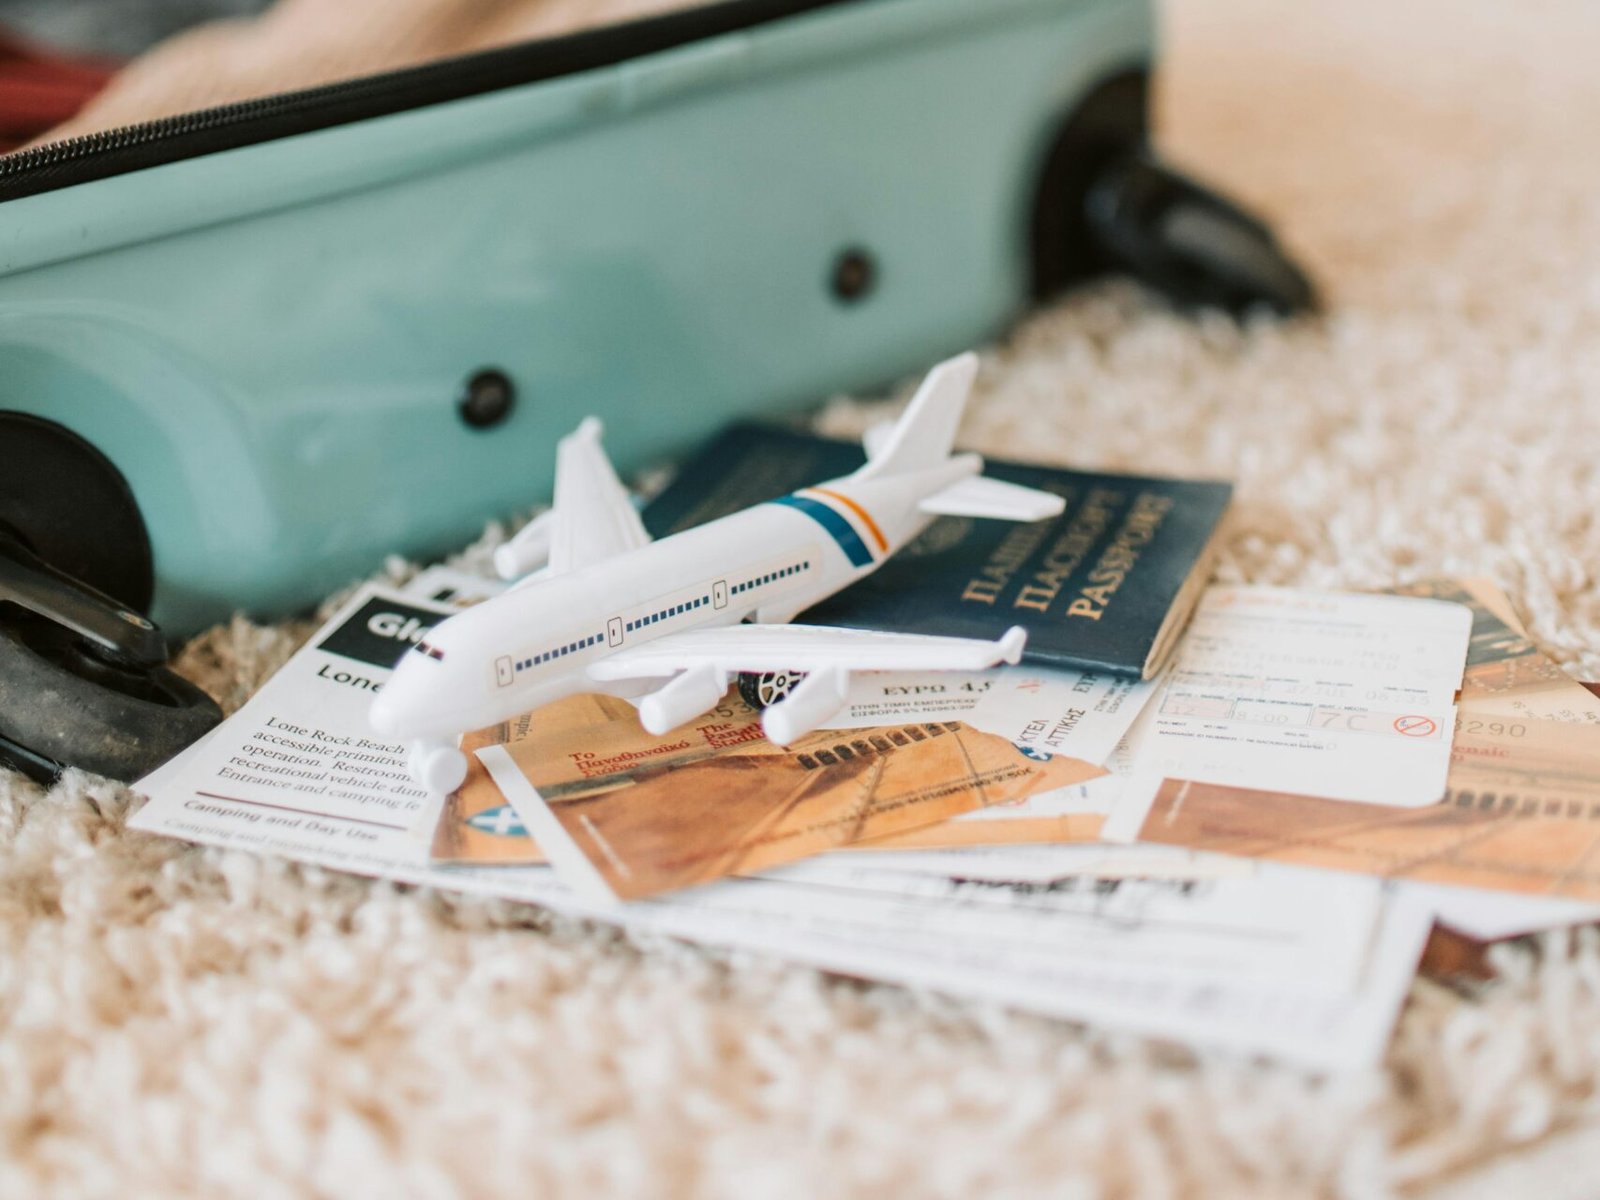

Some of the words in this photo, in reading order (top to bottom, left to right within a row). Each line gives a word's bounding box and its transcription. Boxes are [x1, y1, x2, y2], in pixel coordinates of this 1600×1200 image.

[1066, 492, 1174, 621] PASSPORT
[265, 716, 309, 737] Lone
[311, 729, 353, 747] Rock
[356, 738, 406, 755] Beach
[1045, 707, 1086, 748] ΑΤΤΙΚΗΣ
[242, 743, 323, 769] operation.
[253, 729, 334, 756] accessible
[333, 748, 408, 769] primitive
[216, 766, 292, 790] Entrance
[293, 780, 328, 795] and
[328, 788, 402, 810] camping
[229, 756, 328, 782] recreational
[329, 774, 388, 792] vehicle
[183, 799, 262, 824] Camping
[266, 813, 301, 829] and
[305, 820, 343, 838] Day
